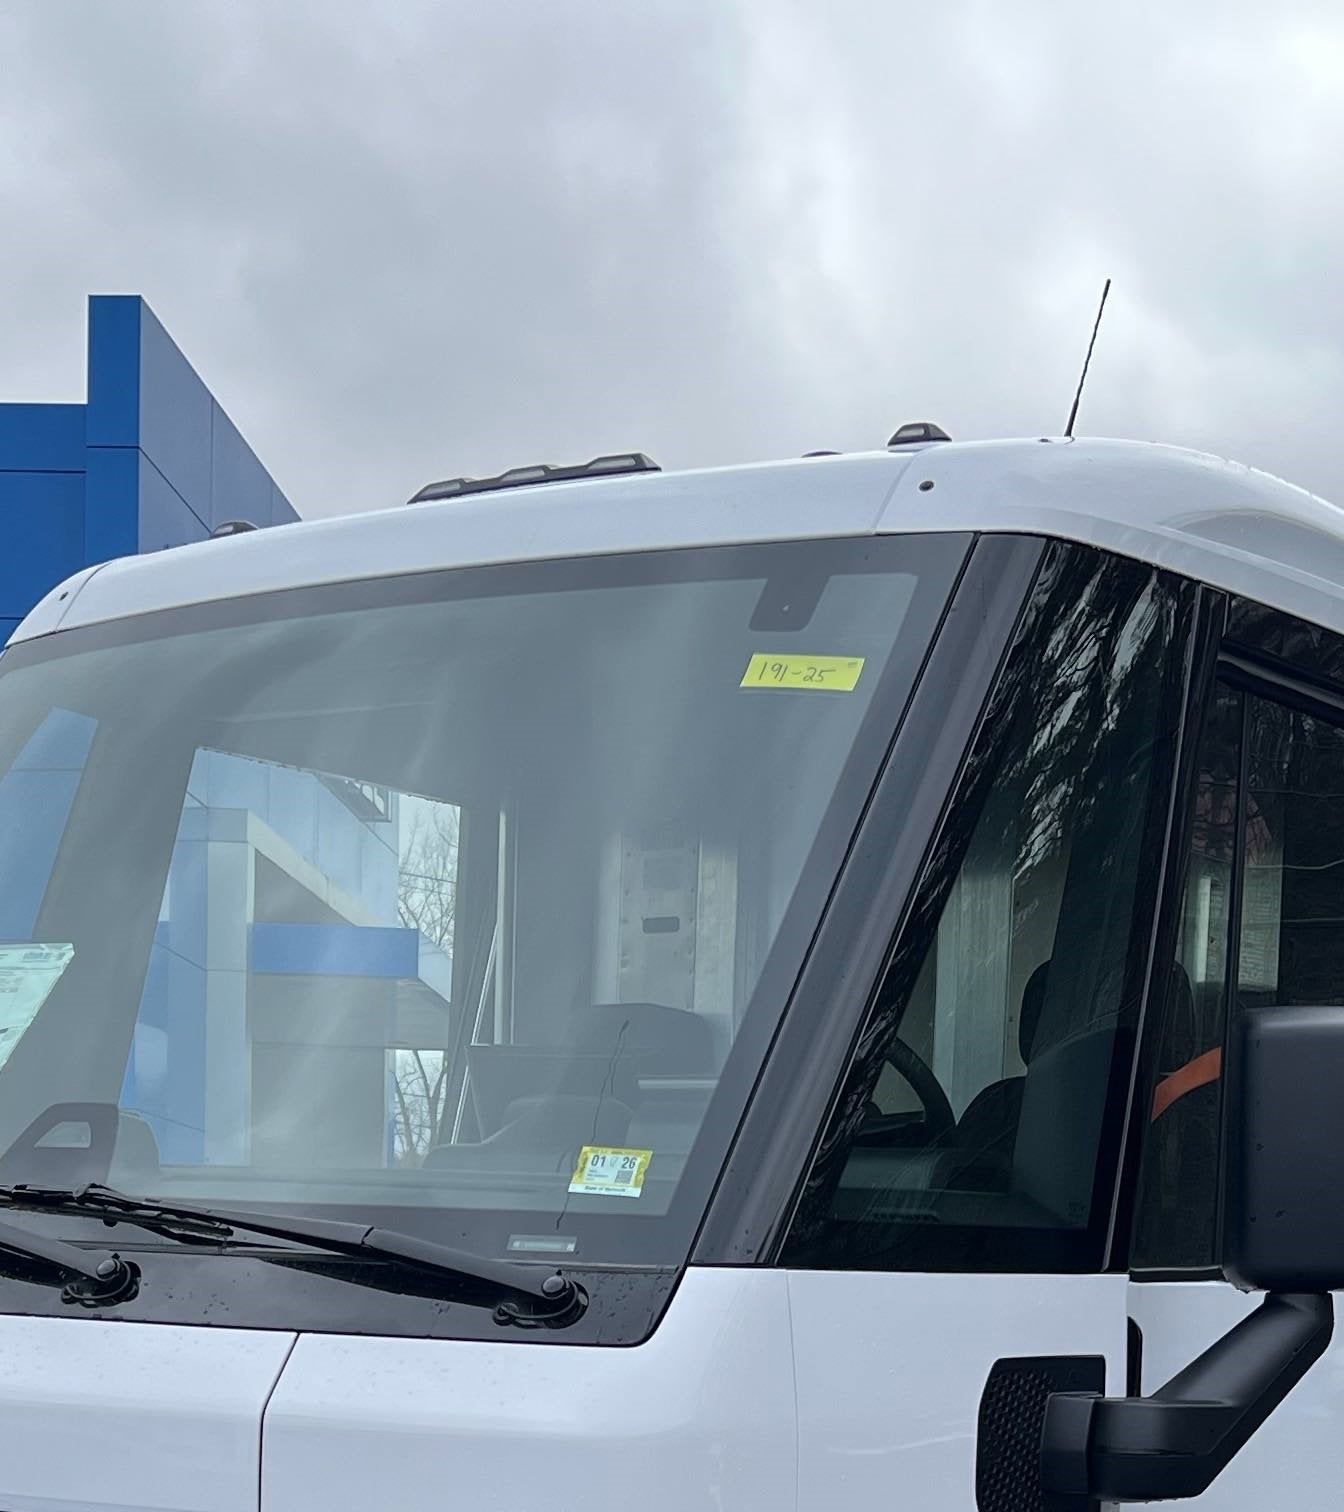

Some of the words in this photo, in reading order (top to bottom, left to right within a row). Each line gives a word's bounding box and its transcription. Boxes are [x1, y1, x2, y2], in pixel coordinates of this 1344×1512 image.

[758, 661, 837, 683] 191-25
[590, 1154, 607, 1169] 01
[620, 1156, 638, 1170] 26
